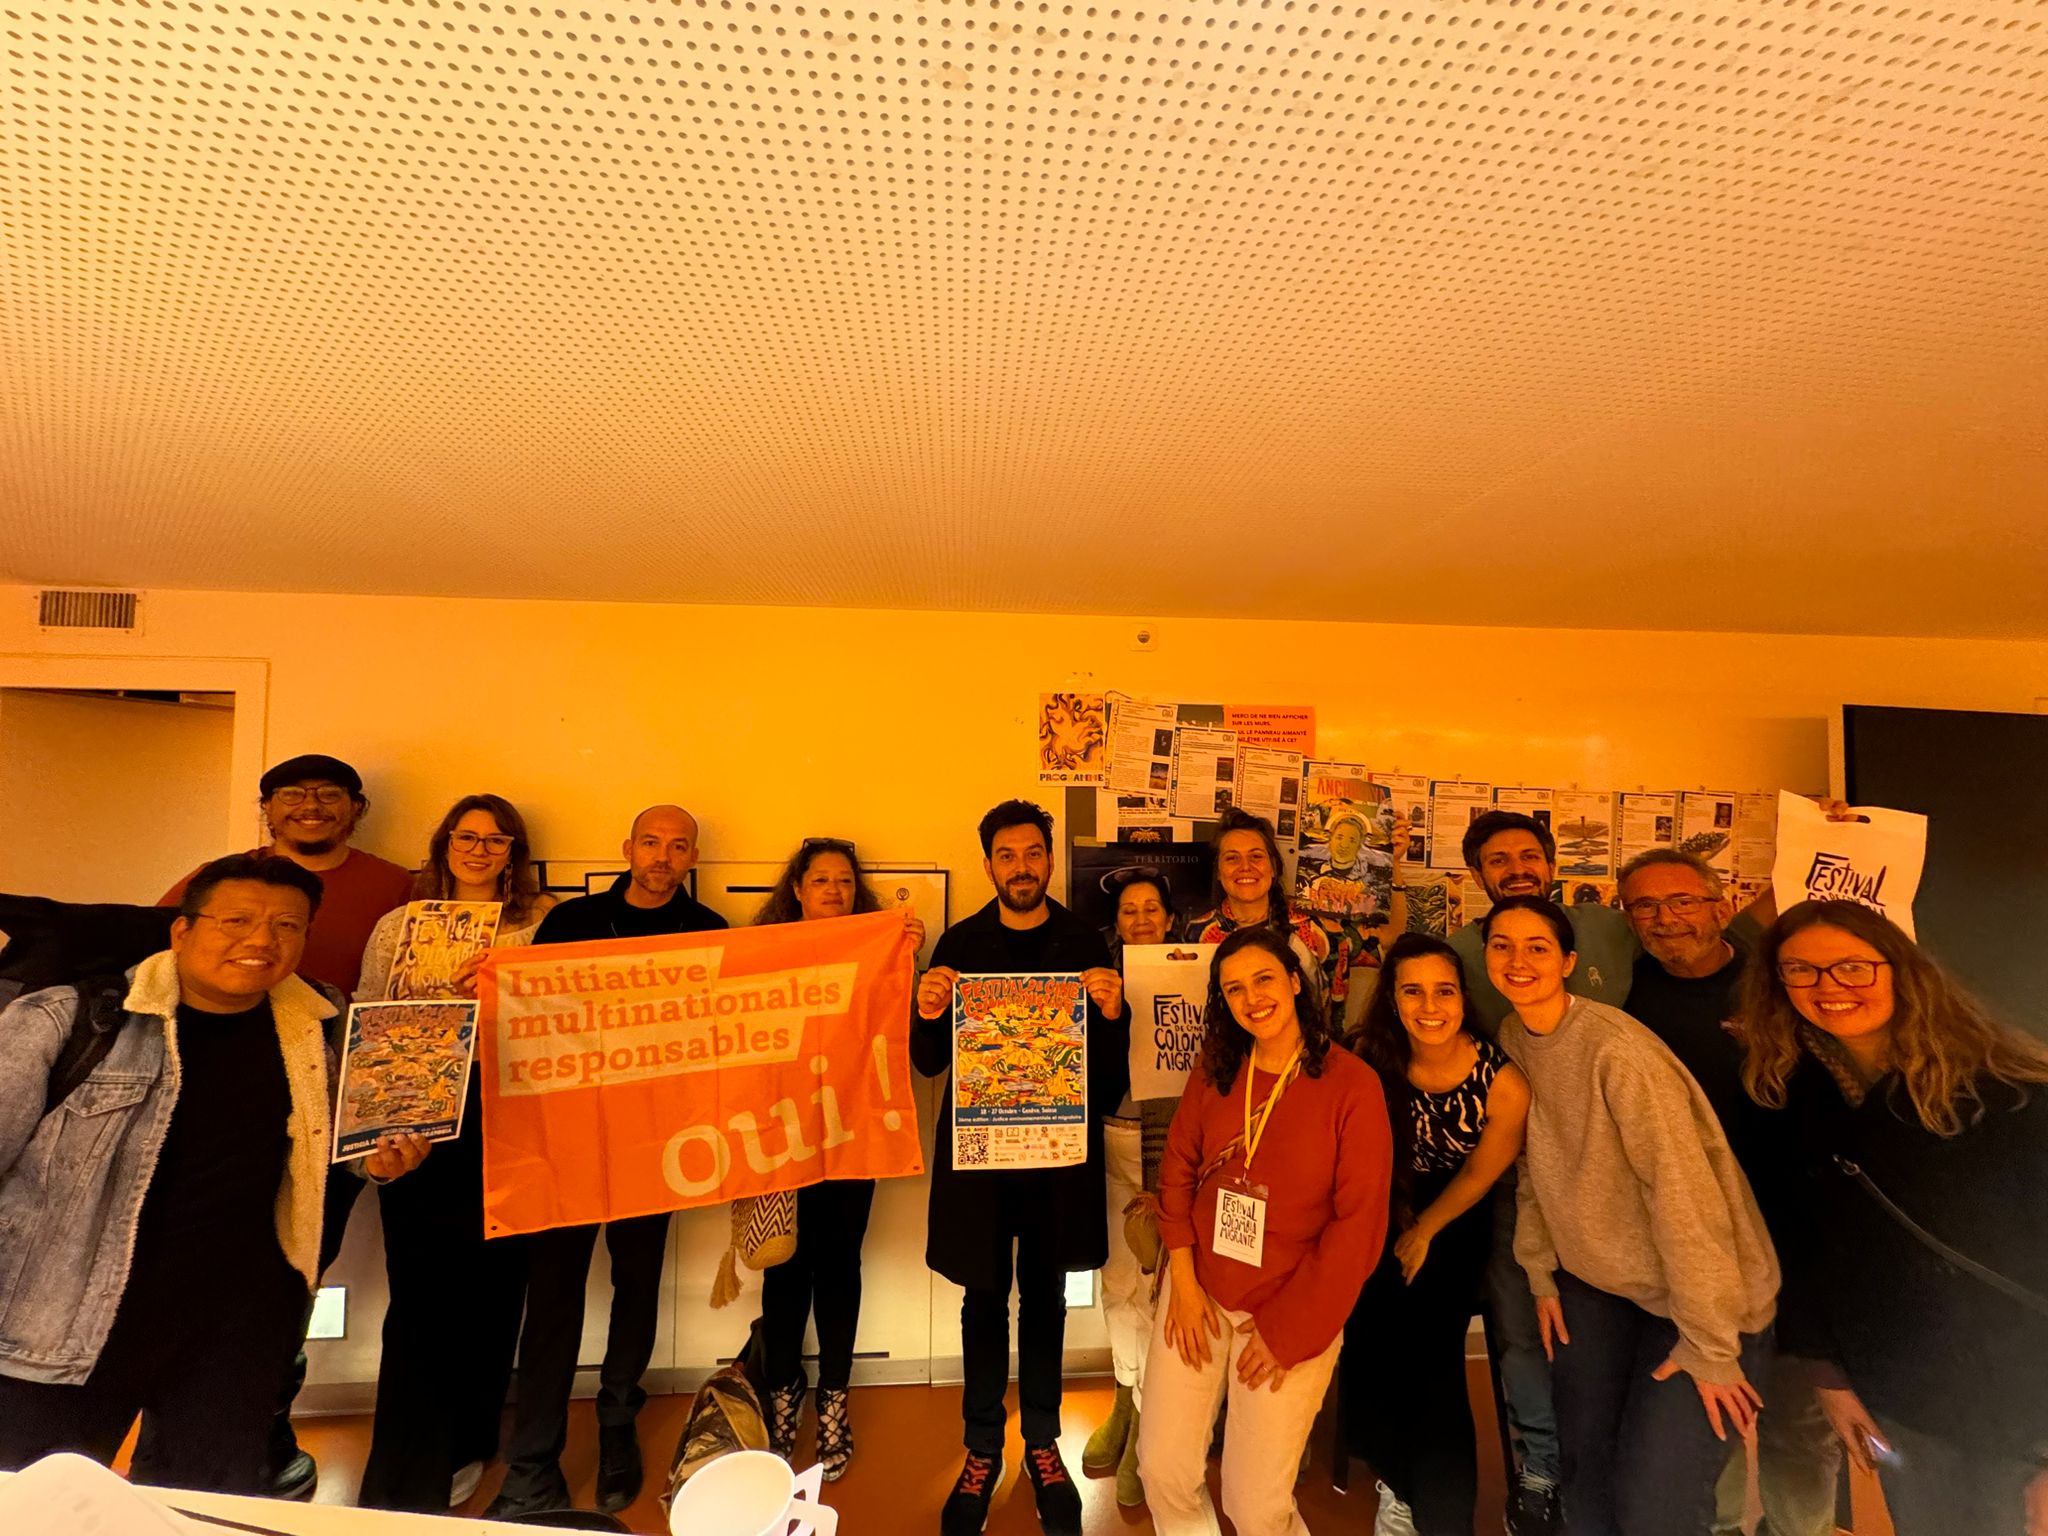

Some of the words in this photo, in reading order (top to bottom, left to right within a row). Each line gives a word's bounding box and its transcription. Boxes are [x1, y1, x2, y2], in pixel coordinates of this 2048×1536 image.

[1040, 773, 1104, 782] PROGAMME
[1134, 855, 1199, 864] TERRITORIO
[1805, 852, 1886, 906] FESTIVAL
[508, 958, 707, 998] Initiative
[508, 976, 841, 1041] multinationales
[1153, 994, 1203, 1027] FESTIV
[508, 1022, 790, 1084] responsables
[1154, 1028, 1204, 1052] COLOM
[1156, 1051, 1196, 1072] MIGR
[662, 1055, 855, 1198] oui
[871, 1034, 902, 1132] !
[1223, 1193, 1258, 1222] FESTIVAL
[1219, 1227, 1256, 1249] MIGRANTE
[1221, 1212, 1257, 1236] COLOMBIA
